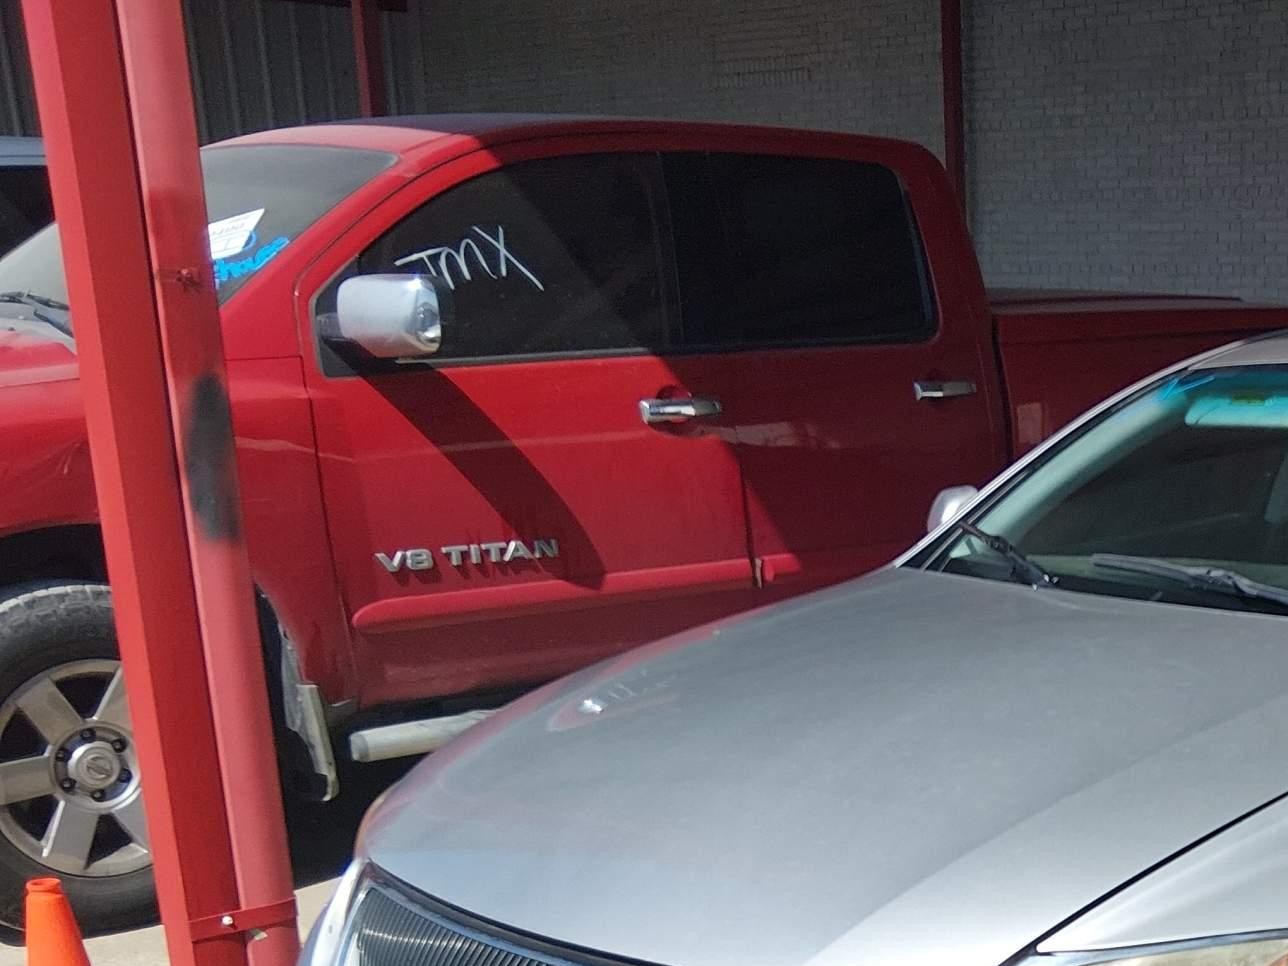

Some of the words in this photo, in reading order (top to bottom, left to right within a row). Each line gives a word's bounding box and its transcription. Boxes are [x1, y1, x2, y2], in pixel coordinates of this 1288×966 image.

[394, 224, 545, 292] TMX
[374, 547, 433, 572] V8
[441, 539, 559, 566] TITAN
